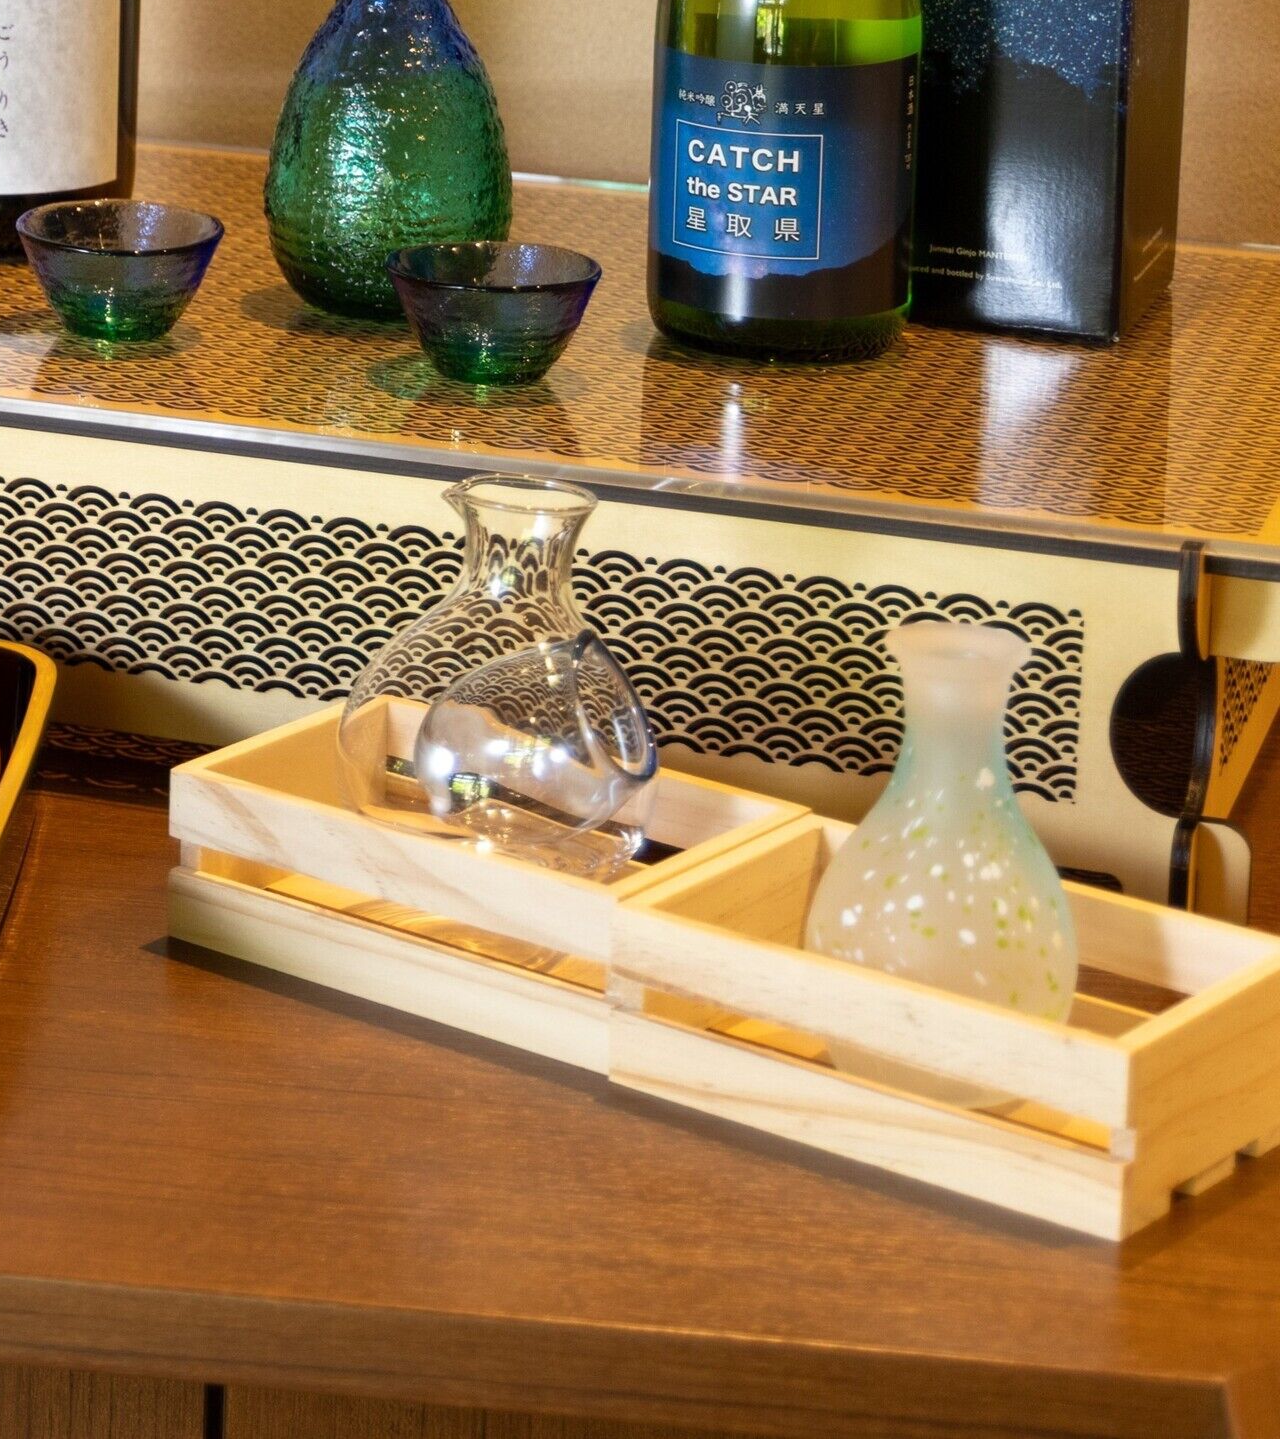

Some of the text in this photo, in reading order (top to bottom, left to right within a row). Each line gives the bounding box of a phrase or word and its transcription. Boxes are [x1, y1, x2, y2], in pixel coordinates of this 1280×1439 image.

[775, 101, 825, 117] 満天星
[688, 139, 800, 174] CATCH
[686, 176, 798, 207] the STAR
[686, 206, 801, 242] 星取県
[929, 243, 955, 255] Junmai
[956, 246, 977, 258] Ginjo
[931, 267, 945, 275] and
[946, 268, 974, 279] bottled
[975, 272, 984, 282] by
